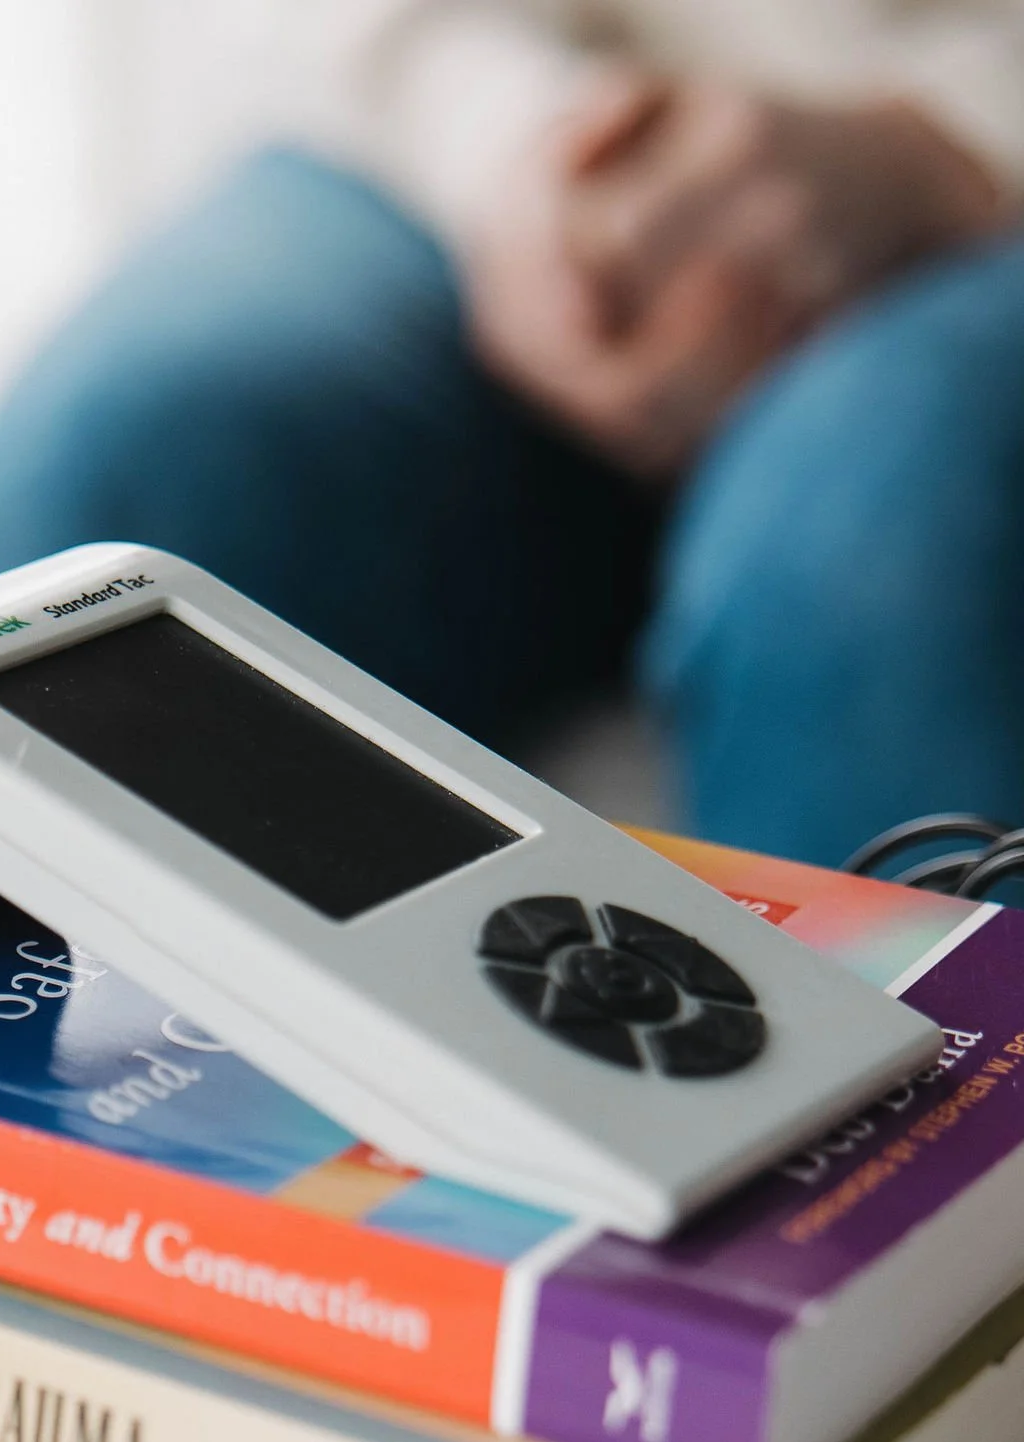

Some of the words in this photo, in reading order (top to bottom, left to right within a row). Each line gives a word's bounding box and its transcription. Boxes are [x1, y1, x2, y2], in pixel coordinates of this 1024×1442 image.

[42, 583, 123, 618] Standard
[117, 572, 156, 594] Tac
[88, 1050, 203, 1125] and
[43, 1212, 144, 1264] and
[142, 1222, 432, 1352] Connection
